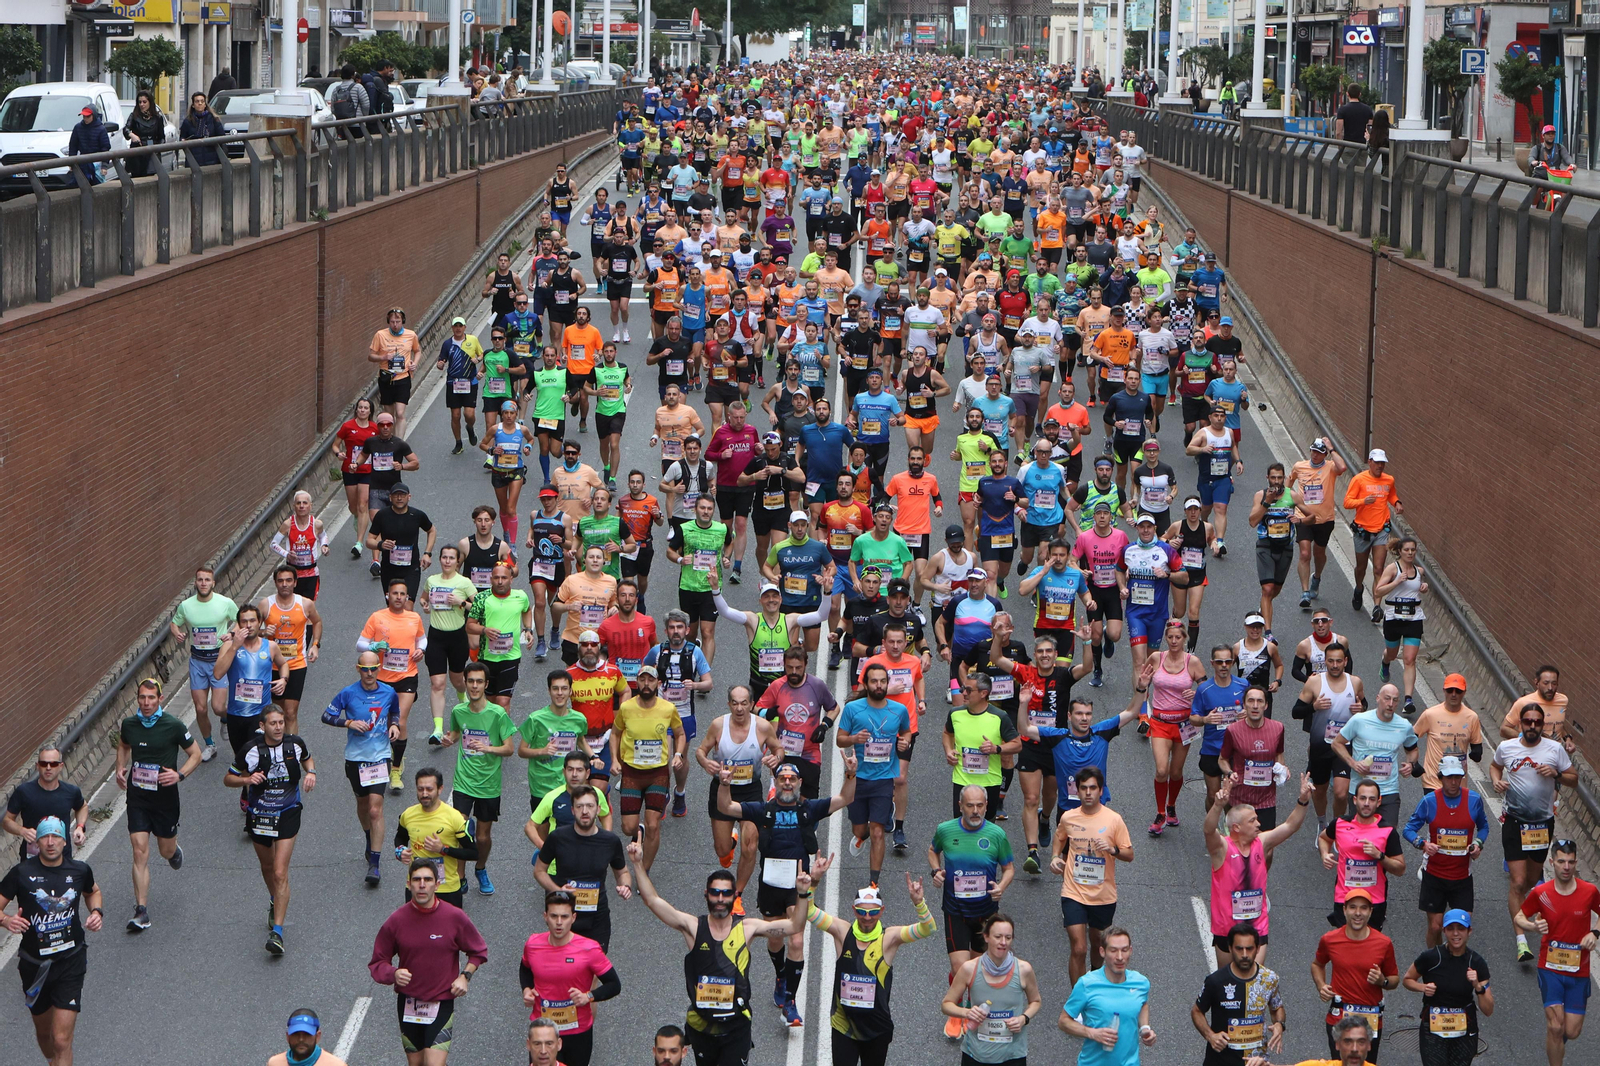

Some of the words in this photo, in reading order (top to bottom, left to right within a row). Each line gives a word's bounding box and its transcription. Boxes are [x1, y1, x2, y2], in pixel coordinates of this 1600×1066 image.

[115, 6, 145, 17] plan
[1466, 52, 1481, 71] P
[908, 484, 925, 495] als
[595, 688, 613, 696] VIVA
[48, 920, 67, 929] ZURICH
